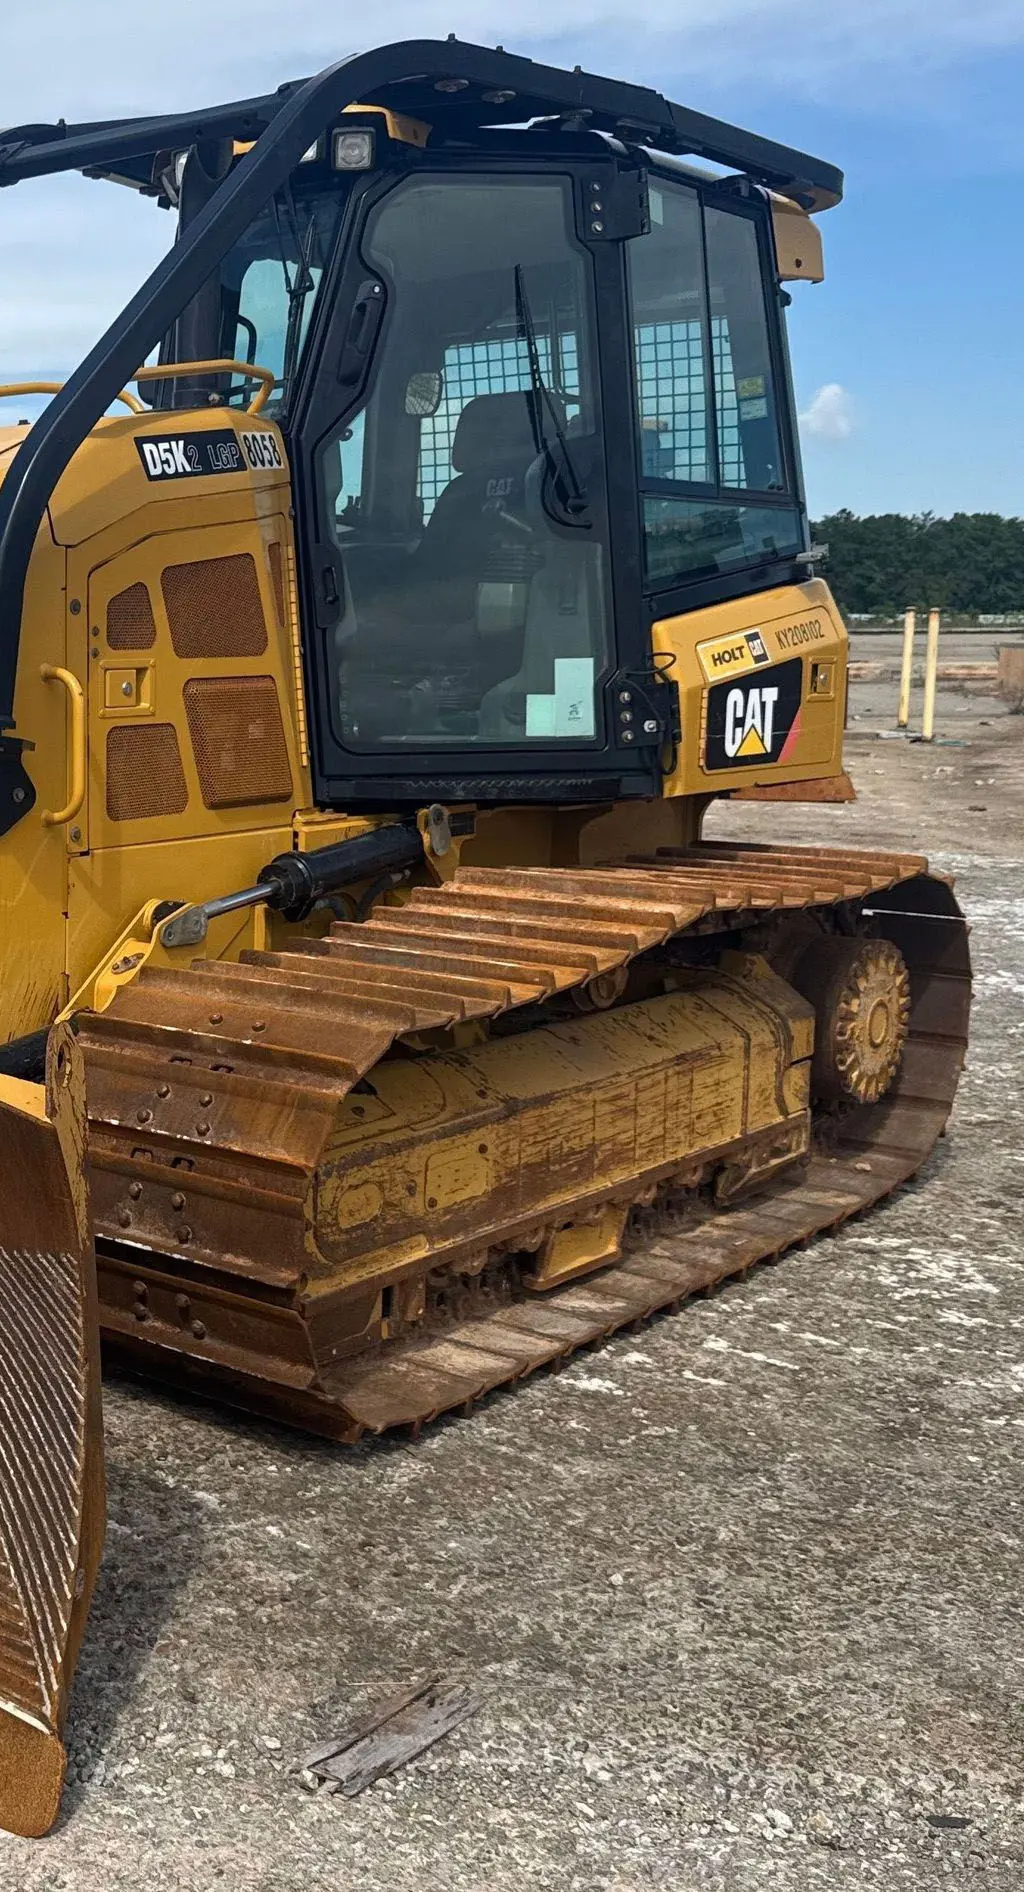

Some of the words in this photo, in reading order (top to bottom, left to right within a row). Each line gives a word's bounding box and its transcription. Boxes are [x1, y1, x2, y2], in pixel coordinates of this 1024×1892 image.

[207, 443, 240, 470] LGP
[243, 433, 282, 468] 8058
[775, 619, 825, 650] KY208102
[711, 645, 745, 667] HOLT
[749, 638, 764, 656] CAT
[725, 687, 778, 757] CAT
